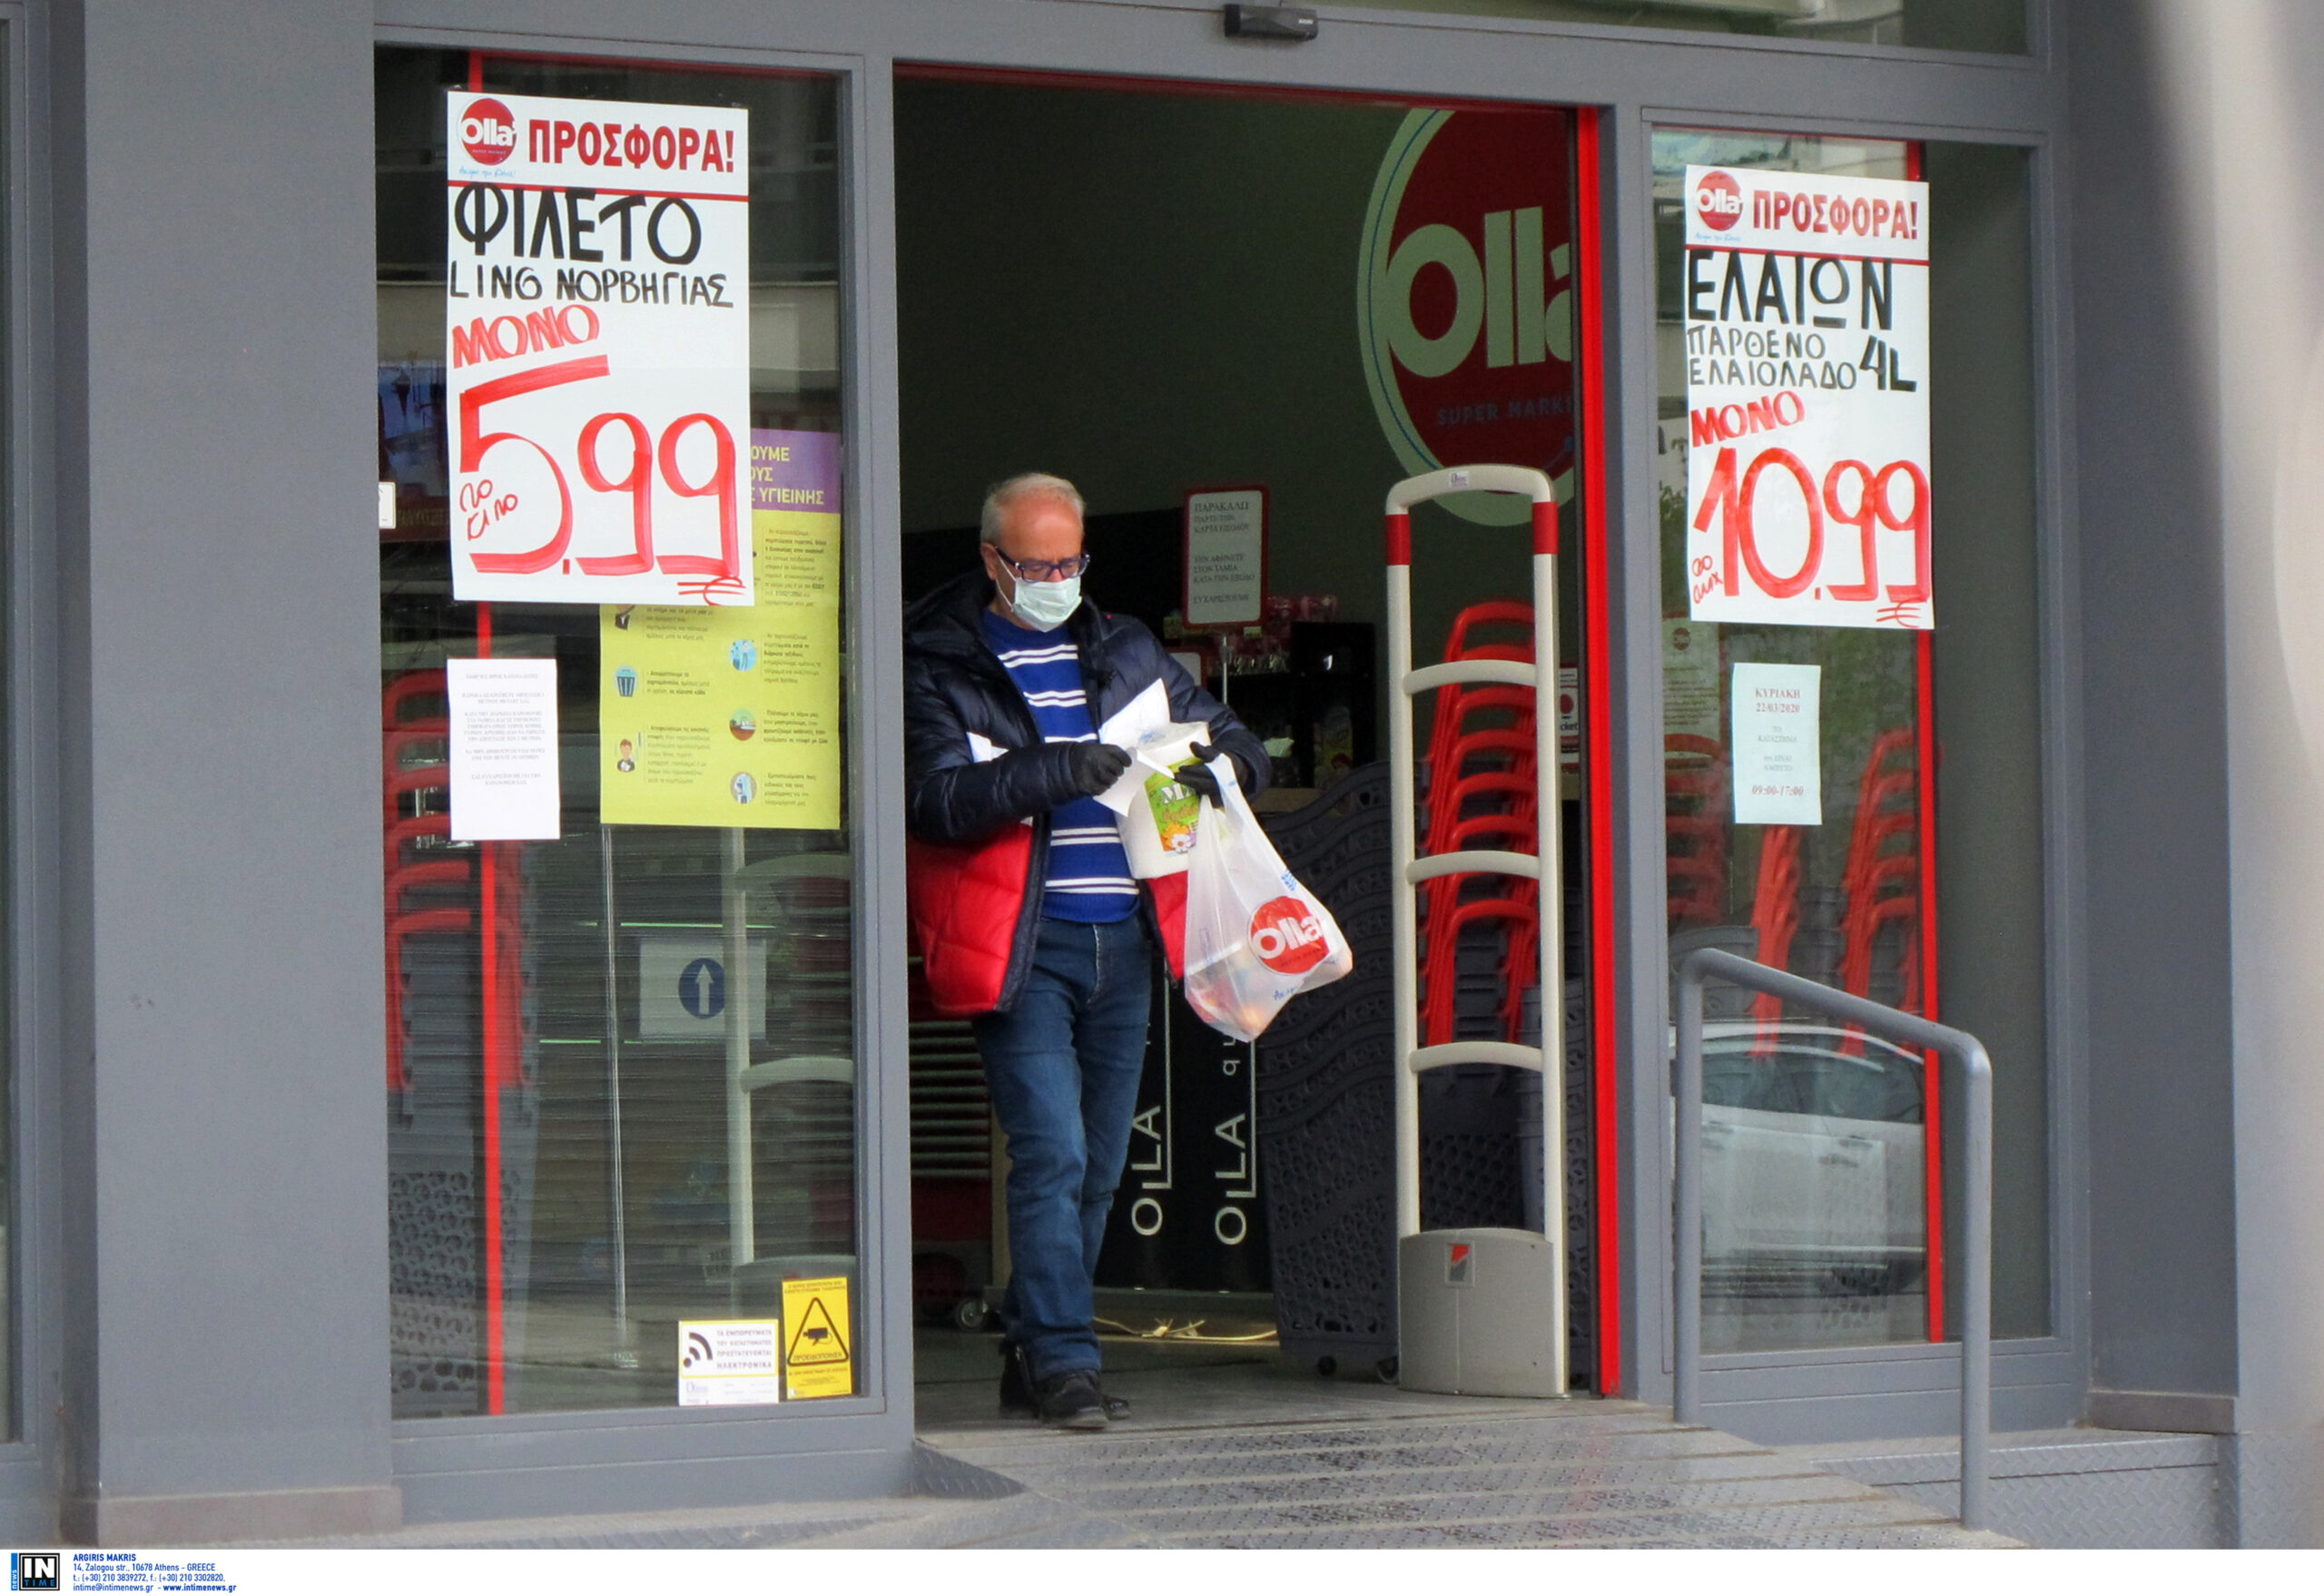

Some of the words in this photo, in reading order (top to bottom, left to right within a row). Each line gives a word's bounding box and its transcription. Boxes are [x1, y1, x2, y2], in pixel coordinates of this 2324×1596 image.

[458, 117, 515, 147] Olla
[529, 119, 734, 172] ΠΡΟΣΦΟΡΑ!
[1697, 188, 1741, 214] Olla
[1753, 190, 1918, 240] ΠΡΟΣΦΟΡΑ!
[455, 182, 702, 265] ΦΙΛΕΤΟ
[449, 261, 542, 301] LING
[556, 267, 734, 308] ΝΟΡΒΗΓΙΑΣ
[1688, 248, 1893, 330] ΕΛΑΙΩΝ
[452, 304, 599, 369] ΜΟΝΟ
[1687, 325, 1826, 360] ΠΑΡΘΕΝΟ
[1689, 358, 1856, 390] ΕΛΑΙΟΛΑΔΟ
[1437, 402, 1500, 426] SUPER
[1690, 390, 1805, 448] ΜΟΝΟ
[751, 445, 791, 462] ΟΥΜΕ
[759, 487, 824, 505] ΥΓΙΕΙΝΗΣ
[1755, 688, 1801, 699] ΚΥΡΙΑΚΗ
[1253, 915, 1323, 960] Olla
